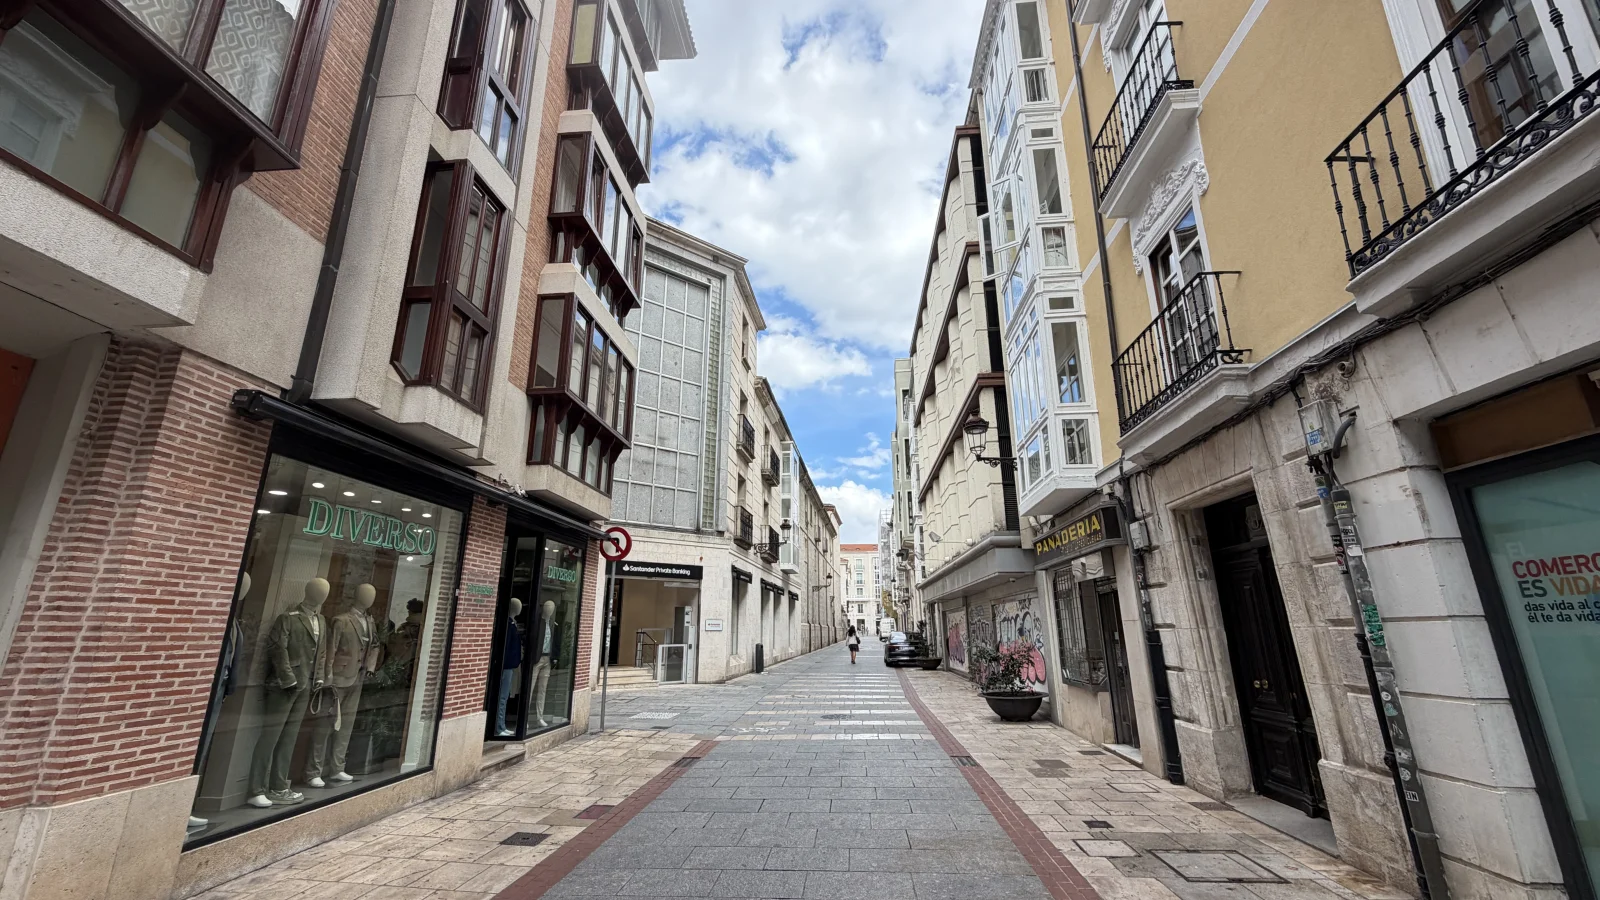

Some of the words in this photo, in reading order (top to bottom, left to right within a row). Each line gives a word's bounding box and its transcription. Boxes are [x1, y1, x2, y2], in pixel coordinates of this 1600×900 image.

[303, 498, 436, 556] DIVERSO
[1036, 515, 1101, 555] PANADERIA
[547, 565, 576, 583] DIVERSO
[629, 565, 656, 573] Santander
[672, 568, 691, 576] Banking
[1517, 579, 1548, 598] ES
[1524, 601, 1546, 612] das
[1547, 599, 1575, 611] vida
[1577, 598, 1591, 610] al
[1527, 612, 1540, 623] él
[1541, 612, 1553, 623] te
[1556, 611, 1573, 622] da
[1575, 610, 1600, 622] vida
